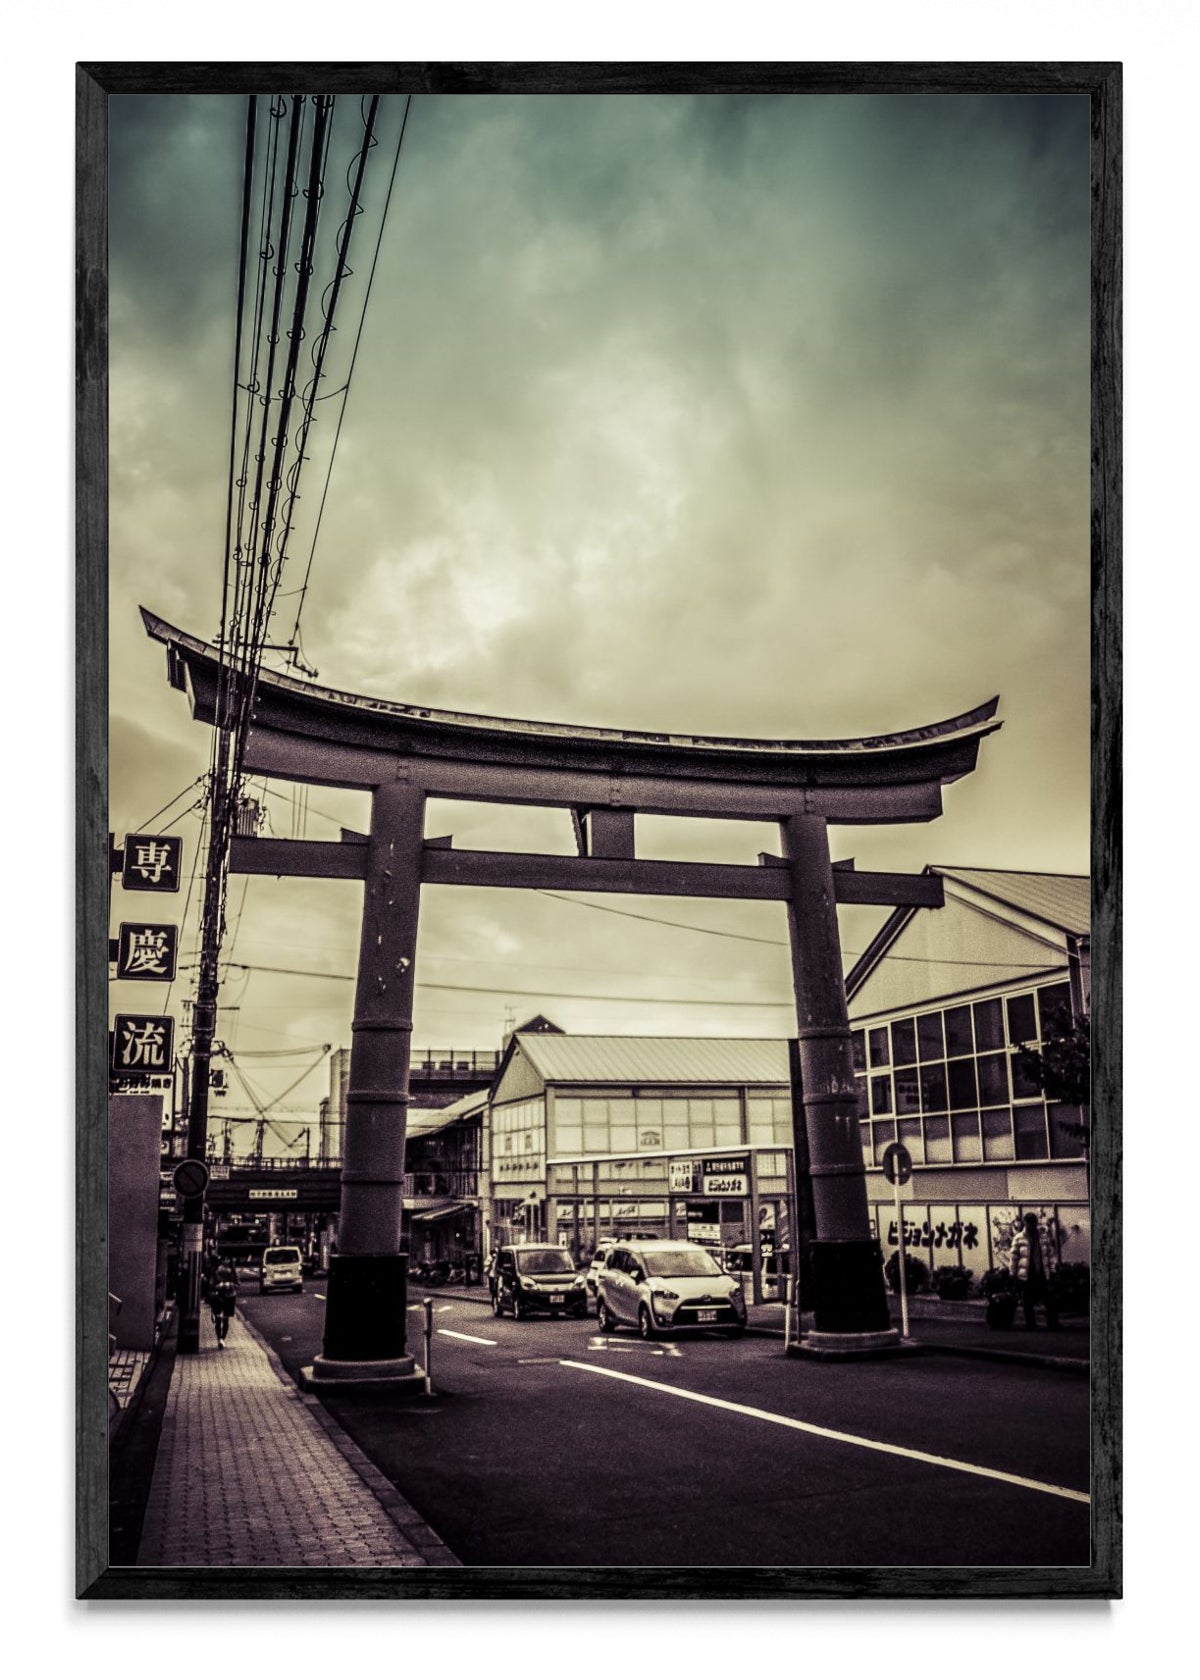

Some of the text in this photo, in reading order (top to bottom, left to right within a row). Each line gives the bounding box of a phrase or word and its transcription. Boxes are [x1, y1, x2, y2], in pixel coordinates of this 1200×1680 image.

[131, 842, 172, 883] 専
[125, 929, 169, 973] 慶
[122, 1021, 165, 1066] 流
[887, 1220, 979, 1250] ビジョンメガネ
